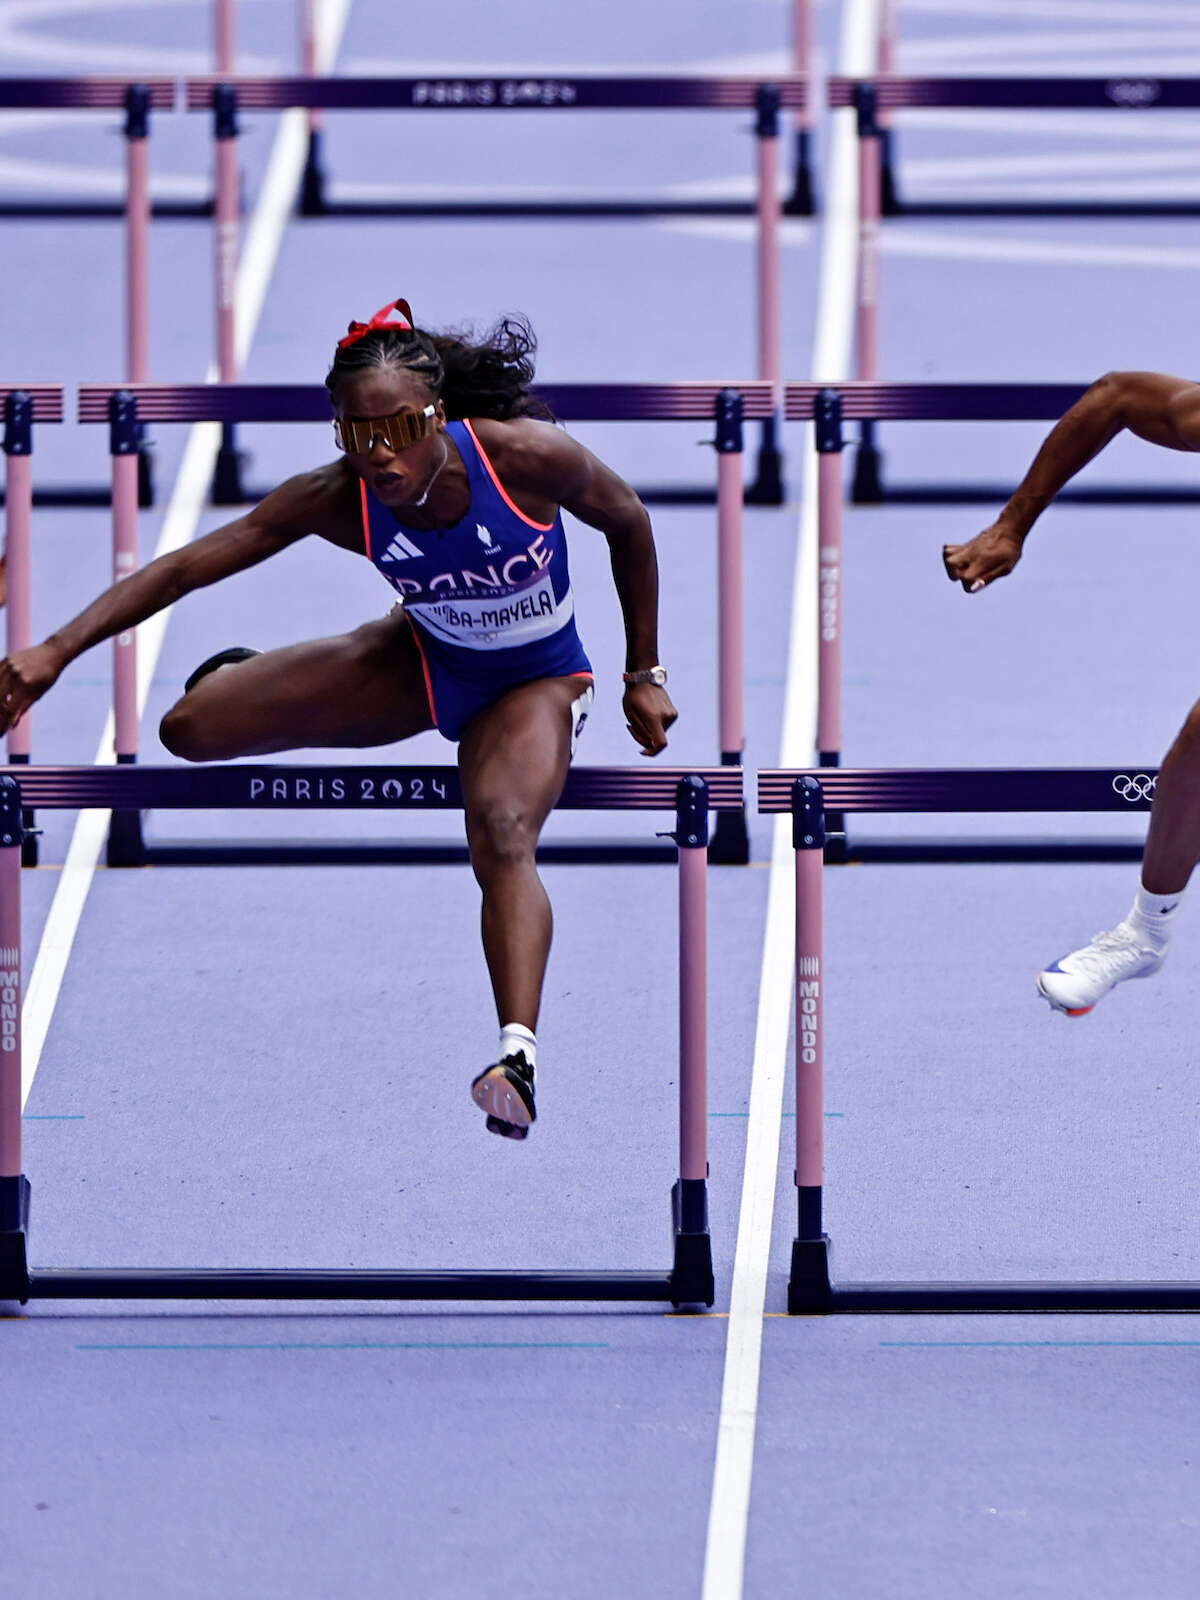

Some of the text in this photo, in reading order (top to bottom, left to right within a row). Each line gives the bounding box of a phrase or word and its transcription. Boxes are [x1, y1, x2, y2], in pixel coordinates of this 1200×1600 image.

[383, 535, 554, 595] RANCE
[360, 778, 446, 800] 2024
[0, 971, 18, 1052] MONDO
[800, 981, 819, 1063] MONDO
